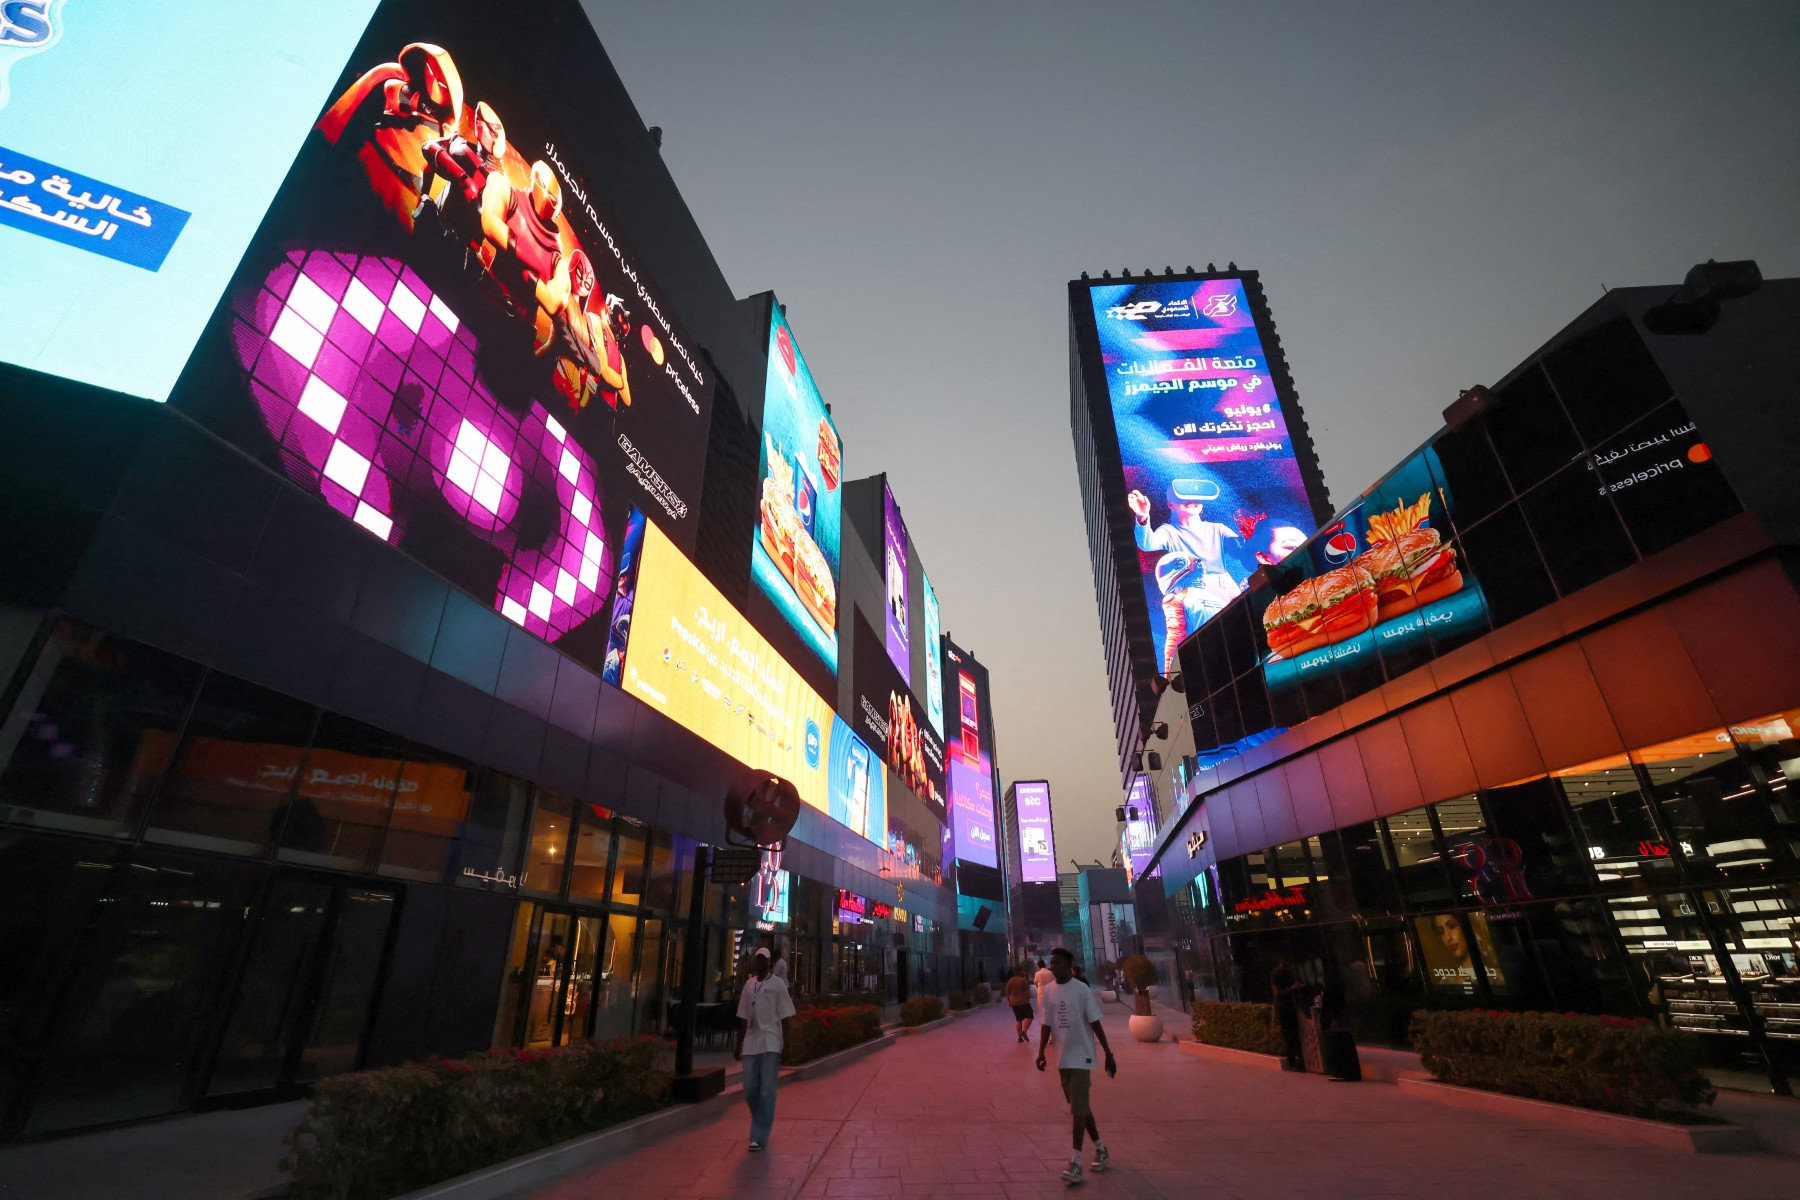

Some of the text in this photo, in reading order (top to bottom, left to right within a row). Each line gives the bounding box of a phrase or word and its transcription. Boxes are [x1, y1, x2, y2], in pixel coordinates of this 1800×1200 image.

[41, 175, 152, 227] خالية
[1211, 356, 1257, 371] متعة
[665, 362, 700, 415] priceless
[1125, 374, 1262, 396] في موسم الجيمرز
[1224, 403, 1271, 418] 6 يوليو
[1199, 422, 1244, 436] تذكرتك
[1246, 420, 1276, 433] احجز
[1201, 441, 1283, 456] بوليفارد رياض سيتي
[1024, 795, 1041, 806] stc
[1107, 912, 1119, 943] ROSHN
